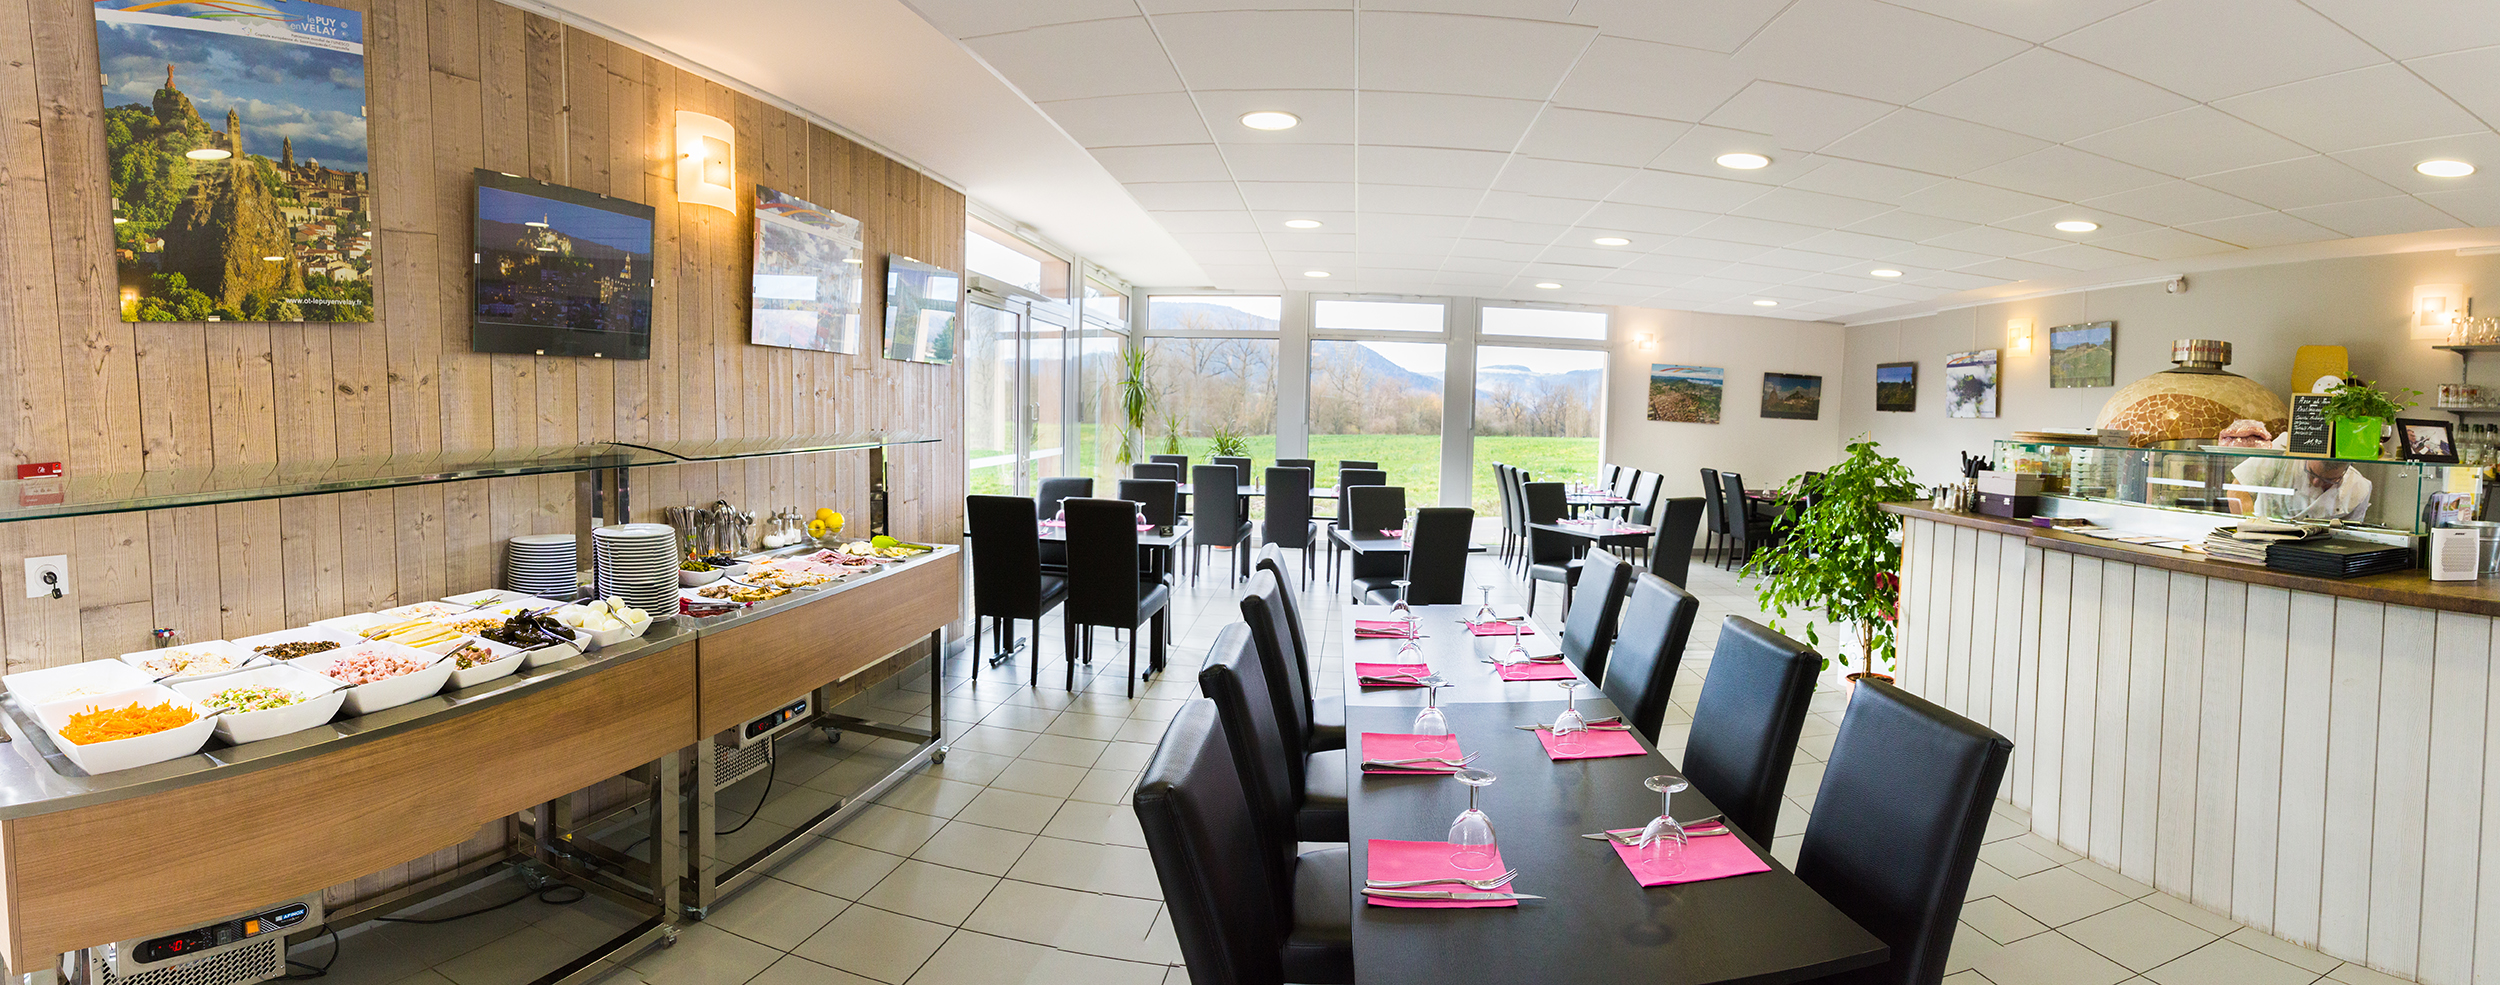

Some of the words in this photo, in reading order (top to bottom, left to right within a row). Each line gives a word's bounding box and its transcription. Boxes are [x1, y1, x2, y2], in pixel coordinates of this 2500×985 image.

[315, 16, 336, 27] PUY
[301, 22, 337, 36] VELAY
[285, 298, 362, 306] www.ot-lepuyenvelay.fr
